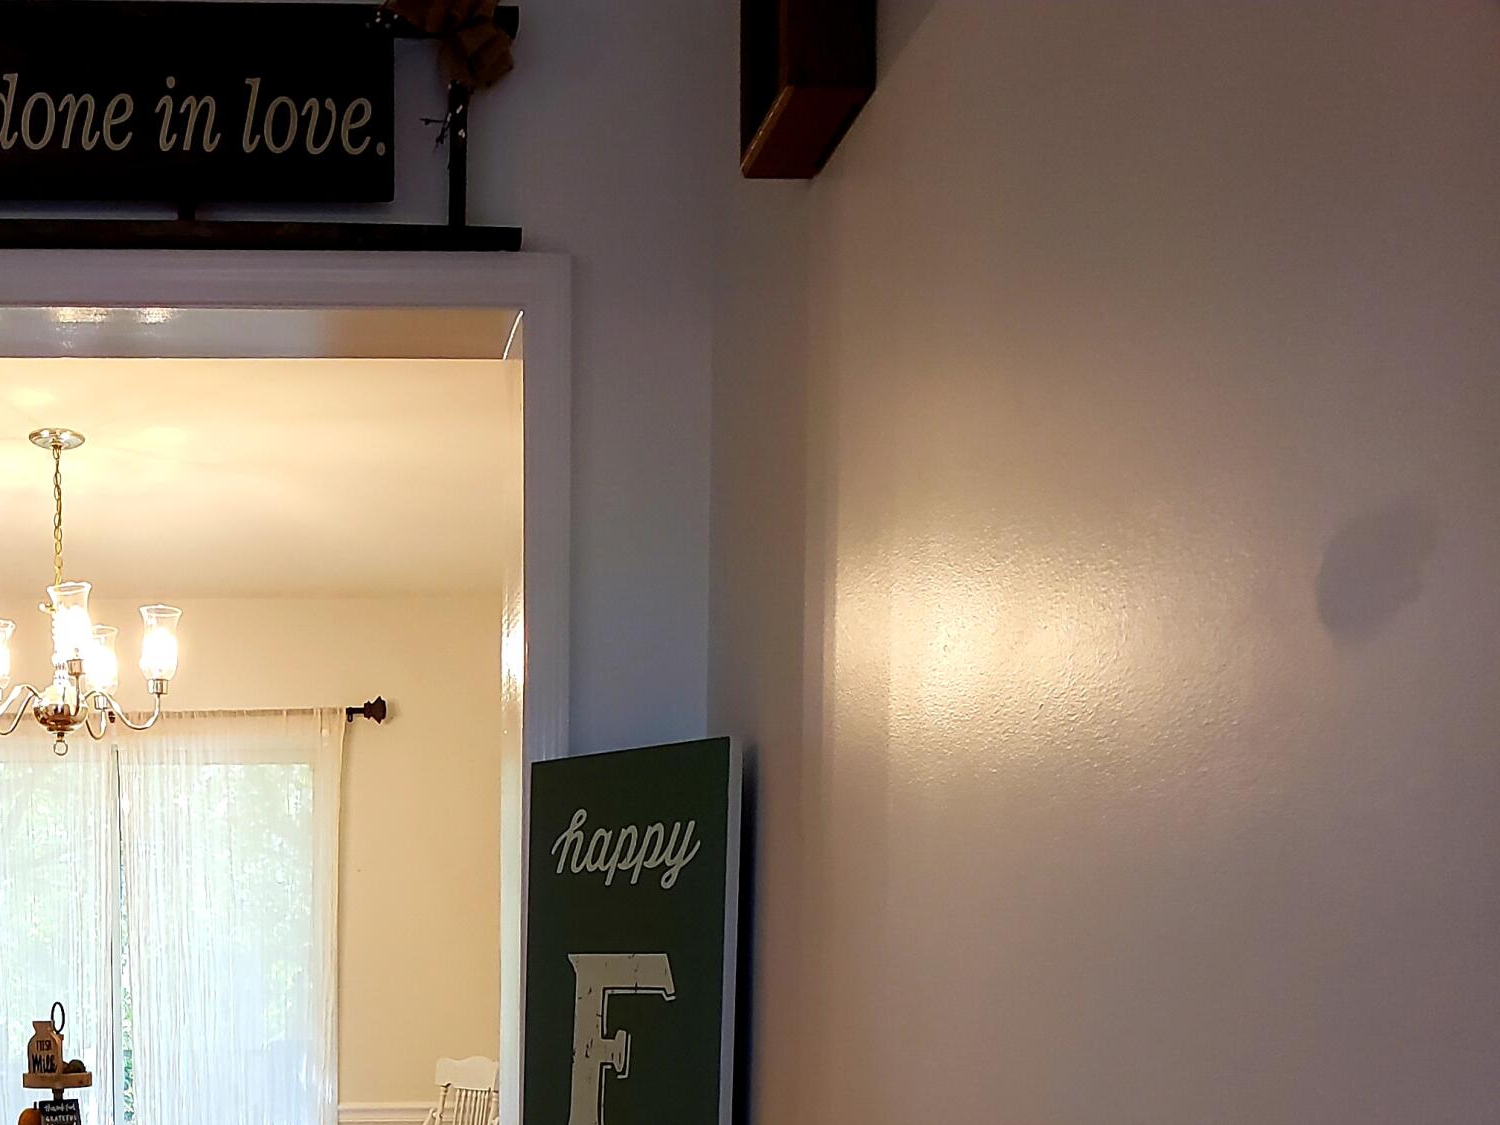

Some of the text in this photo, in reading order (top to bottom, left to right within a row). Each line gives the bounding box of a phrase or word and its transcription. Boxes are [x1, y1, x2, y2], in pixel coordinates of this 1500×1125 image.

[154, 75, 222, 153] in
[241, 77, 388, 156] love.
[551, 808, 701, 889] happy
[32, 1054, 57, 1073] Milk
